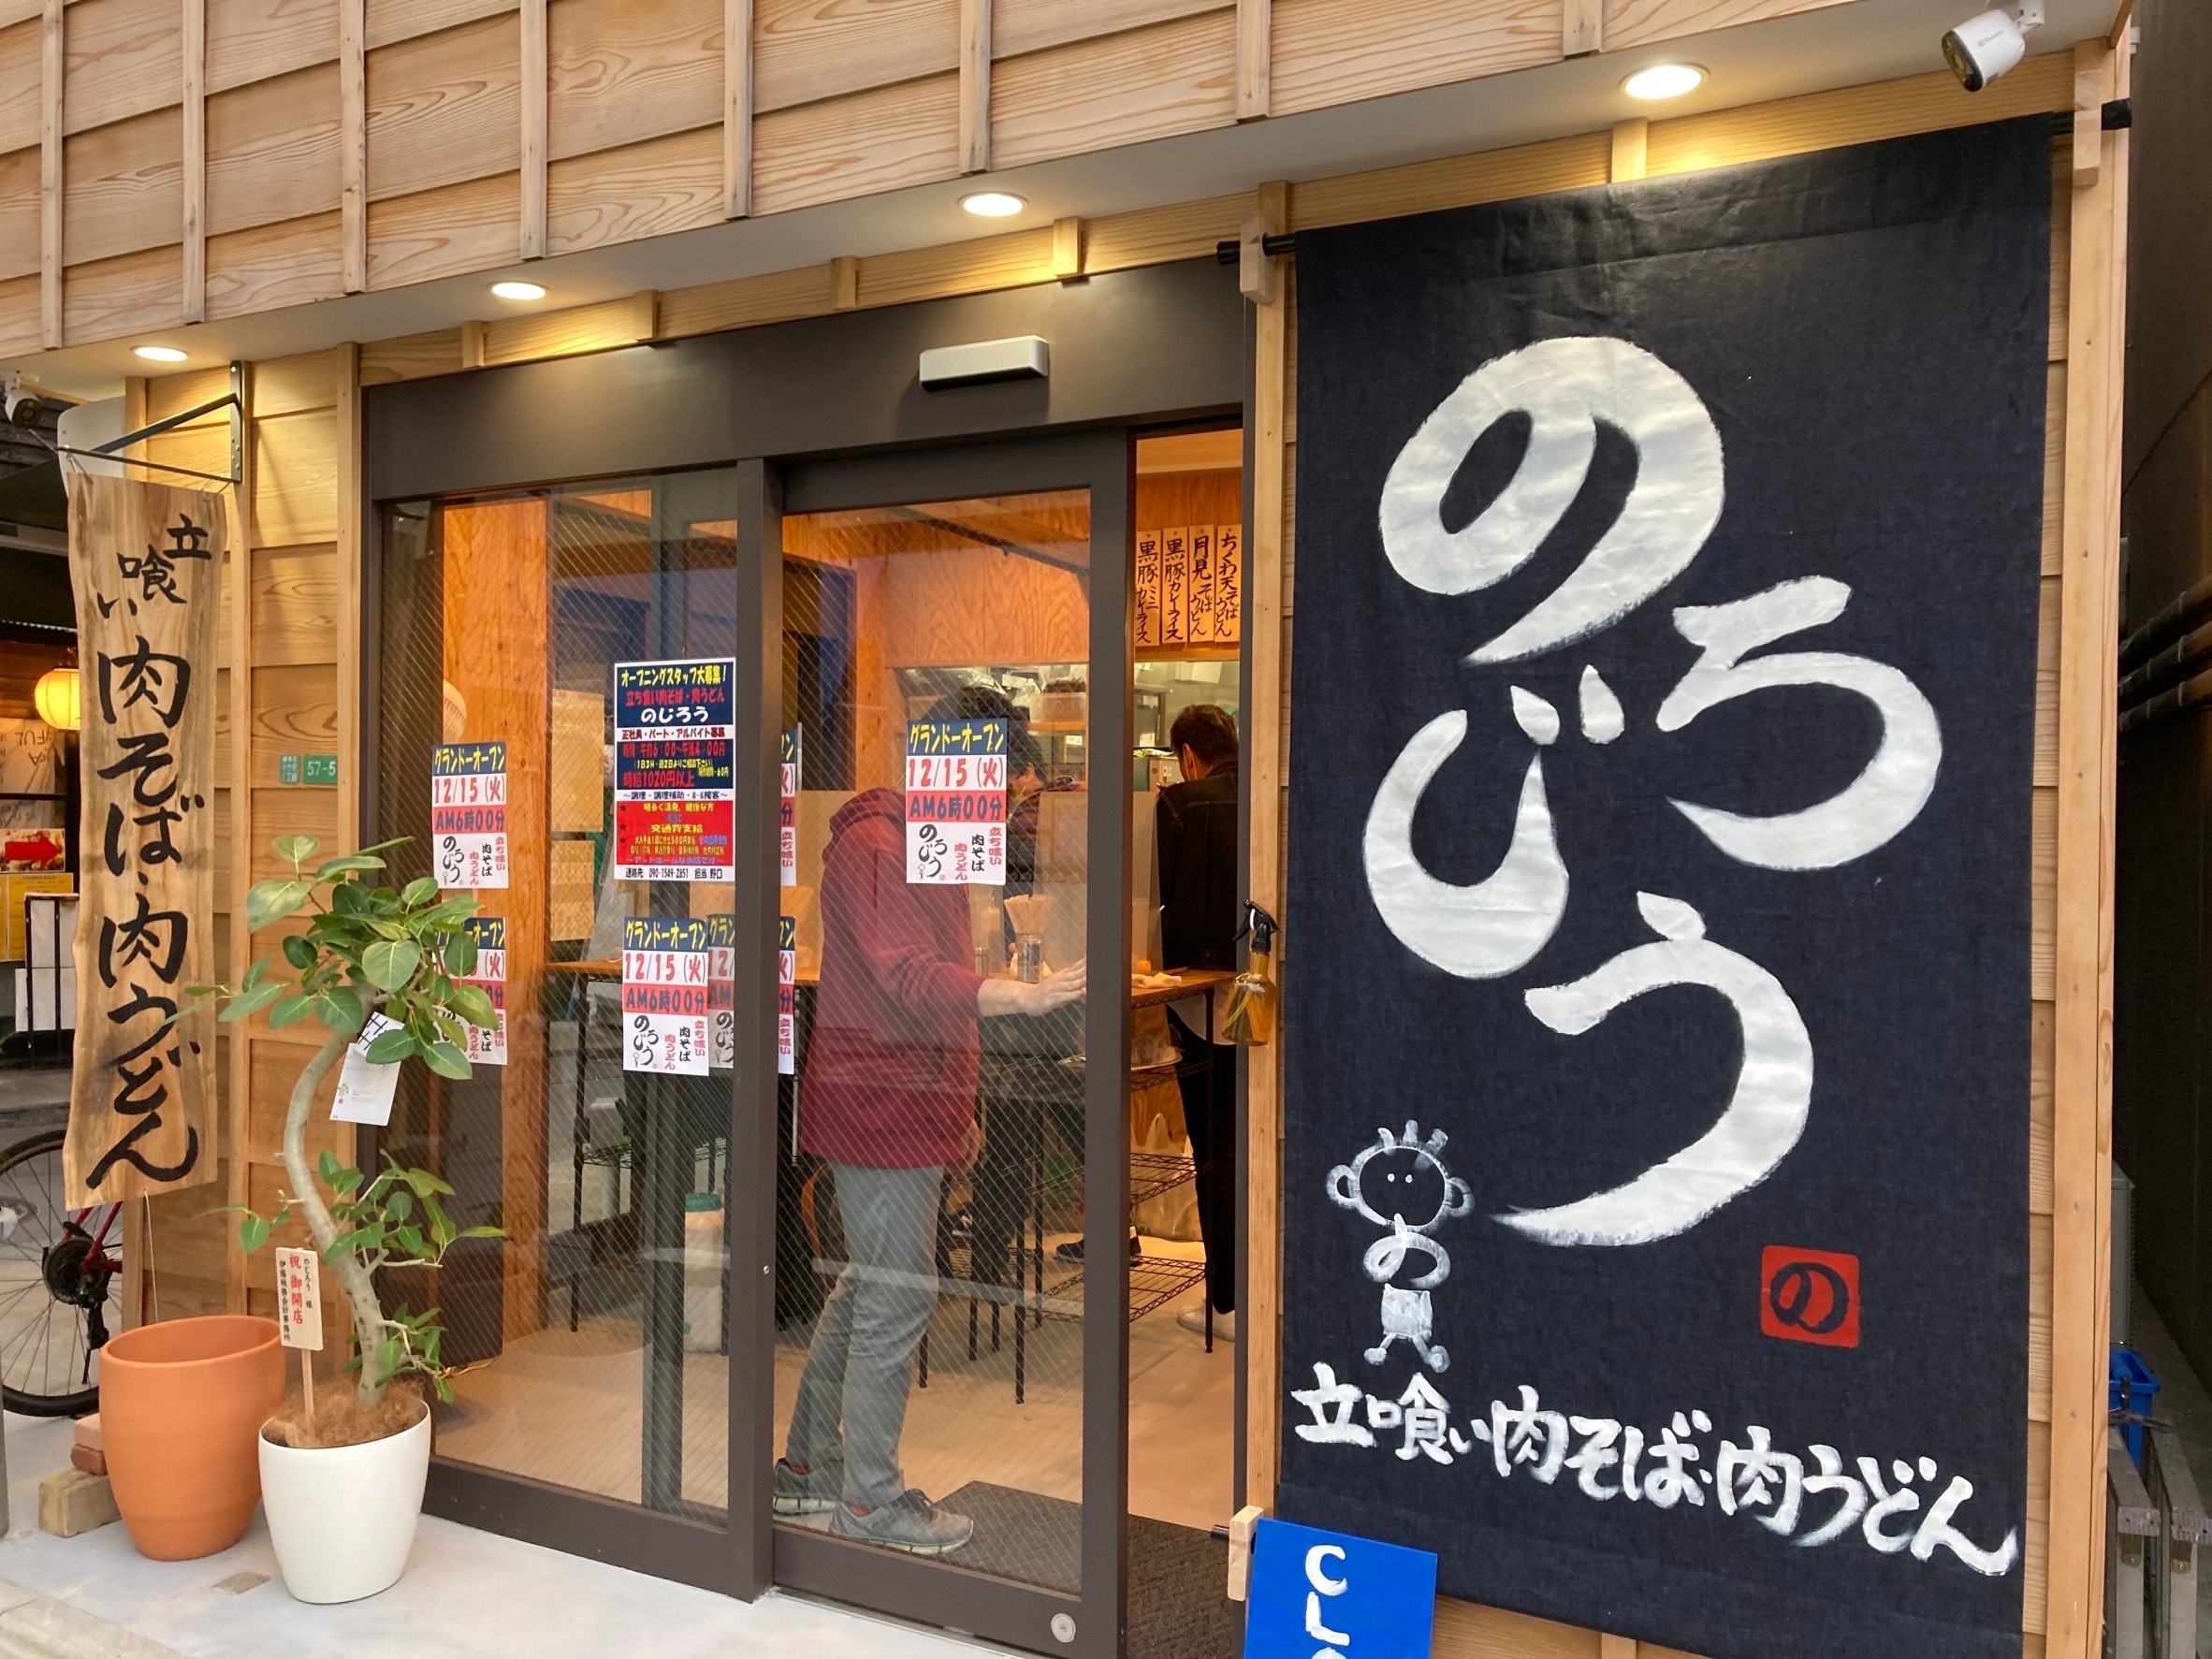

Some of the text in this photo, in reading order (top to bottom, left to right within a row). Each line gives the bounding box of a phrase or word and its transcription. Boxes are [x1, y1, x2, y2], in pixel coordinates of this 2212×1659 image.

[641, 706, 709, 724] のじろう
[307, 761, 336, 777] 57-5
[435, 808, 505, 832] AM6時00分
[910, 795, 1003, 822] AM6時00分
[469, 851, 479, 886] 肉うどん
[482, 843, 492, 877] 肉そば
[954, 842, 968, 881] 肉うどん
[971, 834, 985, 872] 肉そば
[664, 1033, 676, 1070] 肉うどん
[679, 1026, 691, 1063] 肉そば
[1304, 1544, 1351, 1659] CL
